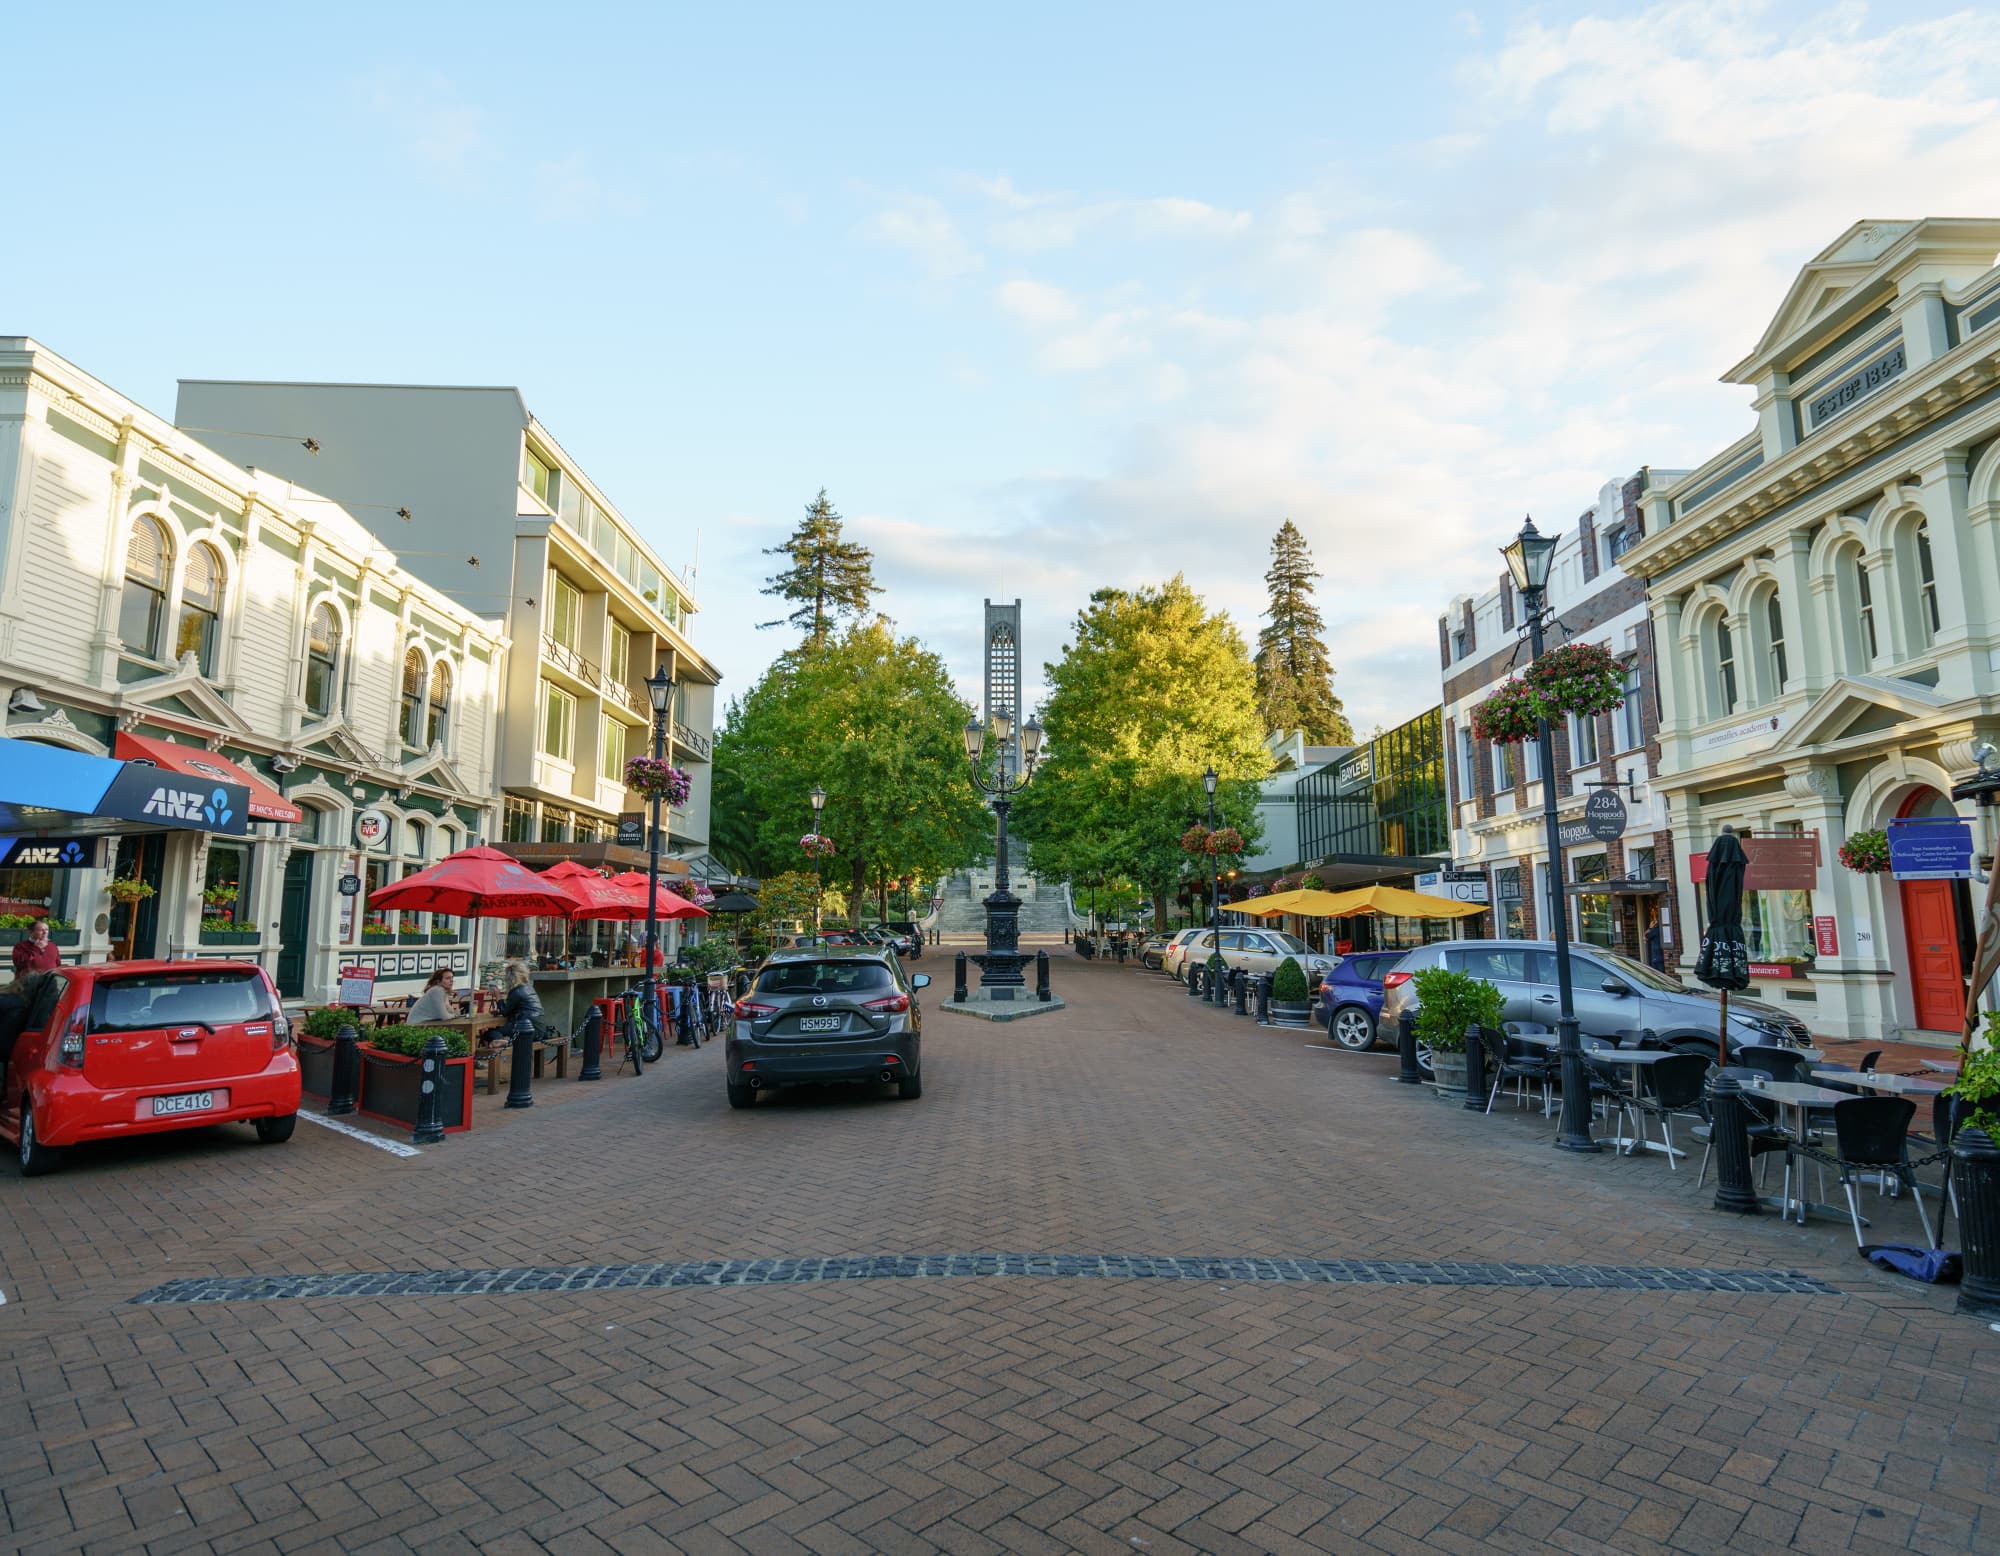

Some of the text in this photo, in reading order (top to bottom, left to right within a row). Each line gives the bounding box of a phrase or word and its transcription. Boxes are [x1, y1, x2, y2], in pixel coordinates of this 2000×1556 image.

[1865, 352, 1904, 389] 1864
[1738, 722, 1769, 736] academy
[1341, 758, 1369, 782] BAYLEYS
[142, 787, 205, 822] ANZ
[1593, 796, 1617, 809] 284
[274, 808, 296, 819] NELSON
[1587, 810, 1624, 820] Hopgoods
[366, 825, 377, 835] VIC
[14, 847, 60, 864] ANZ
[1450, 883, 1484, 900] ICE
[10, 896, 21, 904] VIC
[1856, 932, 1871, 941] 280
[801, 1018, 840, 1029] HSM993
[155, 1095, 212, 1113] DCE416
